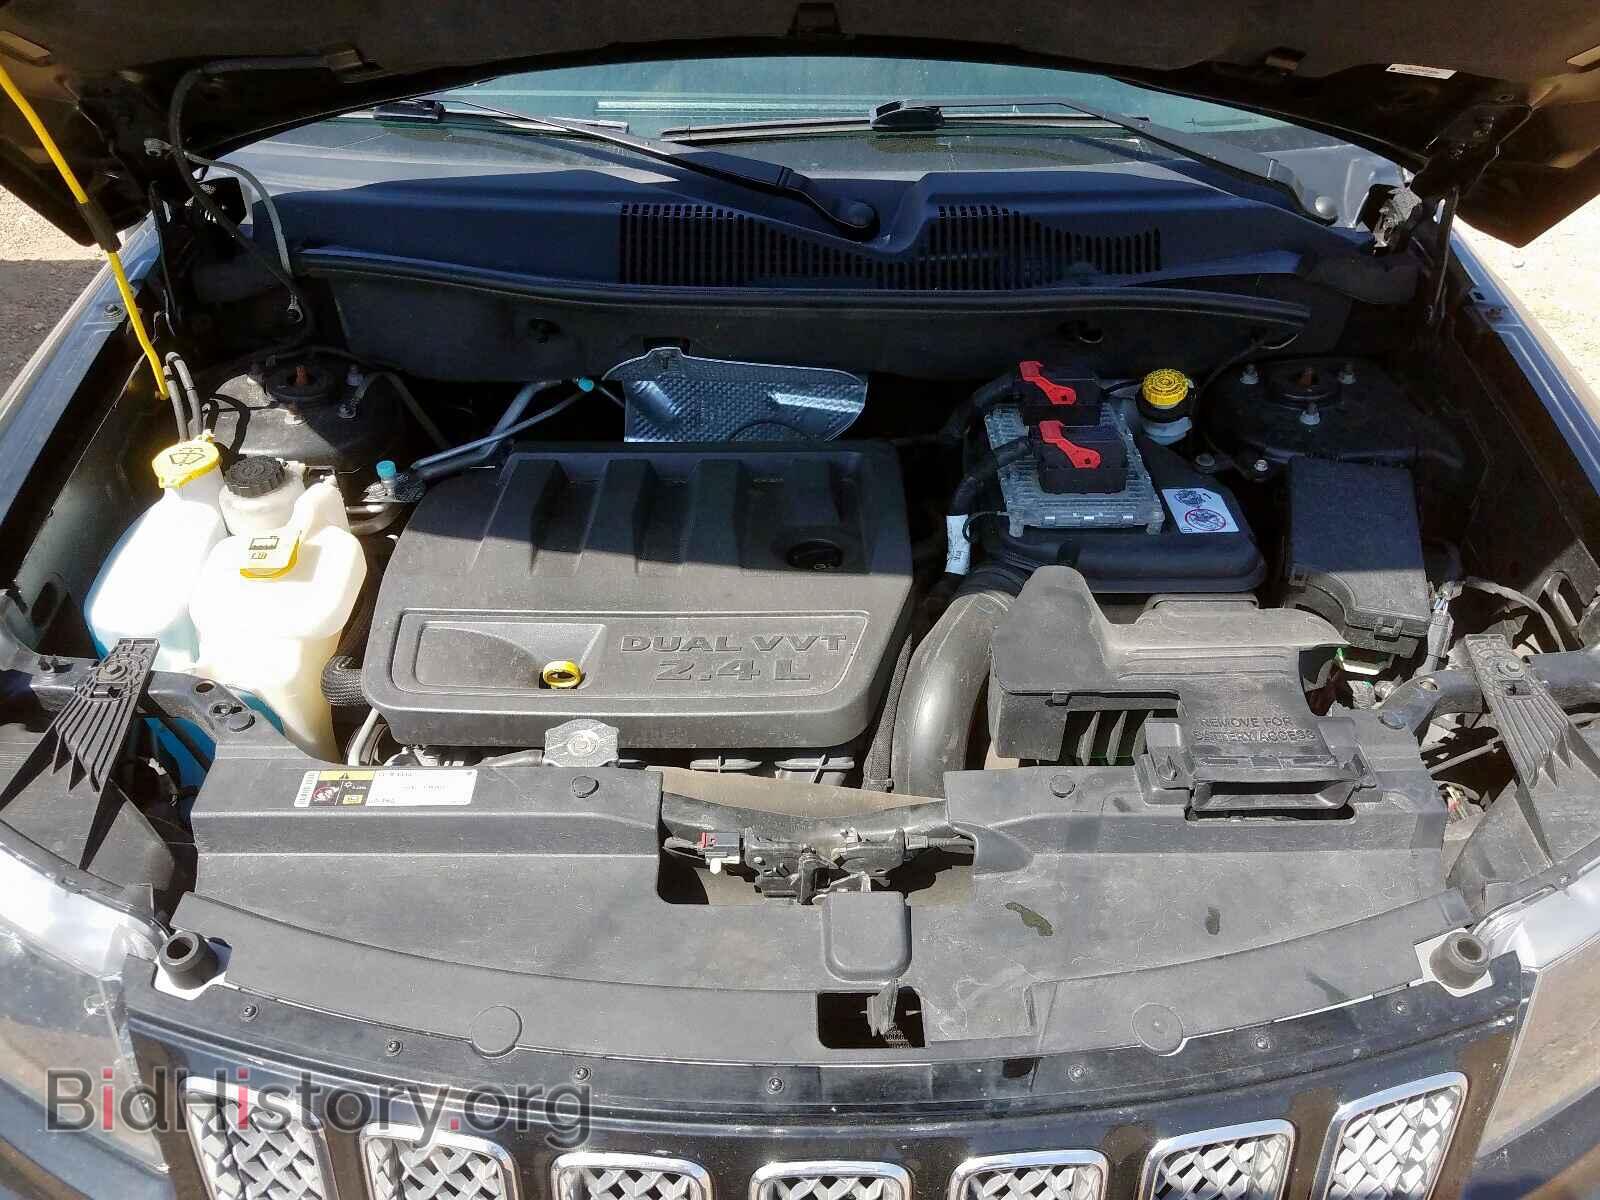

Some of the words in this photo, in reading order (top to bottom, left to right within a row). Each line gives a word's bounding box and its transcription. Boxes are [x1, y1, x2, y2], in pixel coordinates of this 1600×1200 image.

[621, 634, 742, 652] DUAL
[752, 634, 847, 652] VVT
[1200, 718, 1260, 728] REMOVE
[1263, 716, 1293, 728] FOR
[1259, 729, 1316, 742] ACCESS
